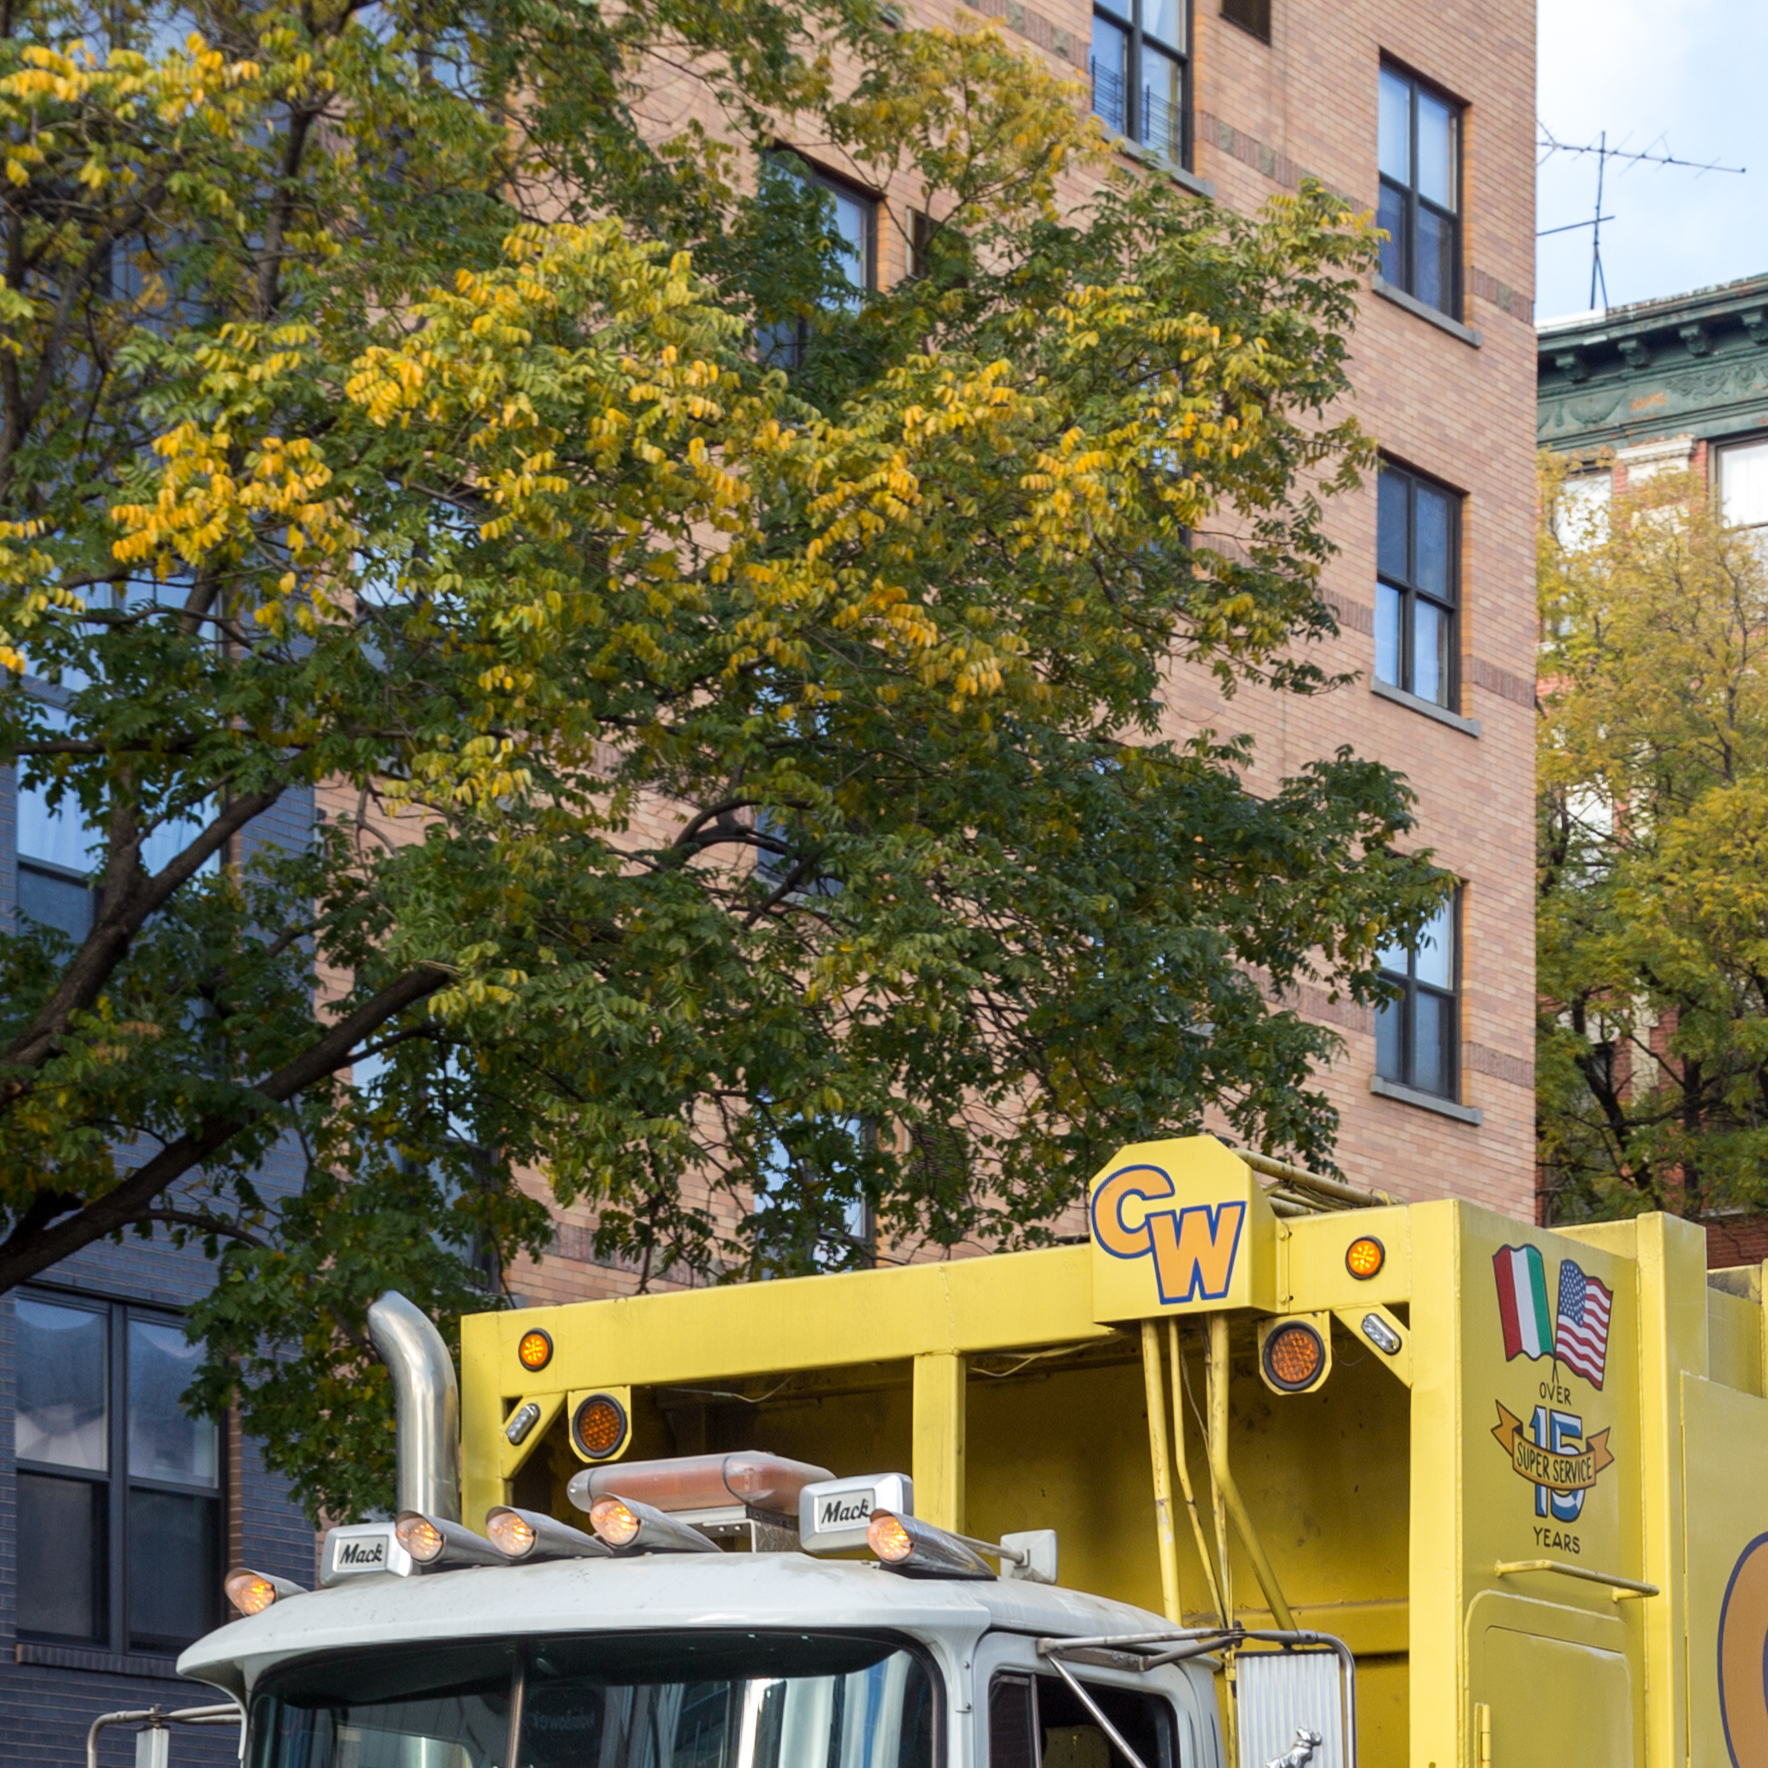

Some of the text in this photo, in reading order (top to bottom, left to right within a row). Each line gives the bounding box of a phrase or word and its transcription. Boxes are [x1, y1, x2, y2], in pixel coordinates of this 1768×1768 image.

[1538, 1381, 1572, 1406] OVER
[1516, 1441, 1593, 1485] SUPER SERVICE
[1528, 1404, 1586, 1524] 15
[820, 1498, 872, 1524] Mack
[1532, 1525, 1581, 1555] YEARS
[339, 1542, 384, 1567] Mack
